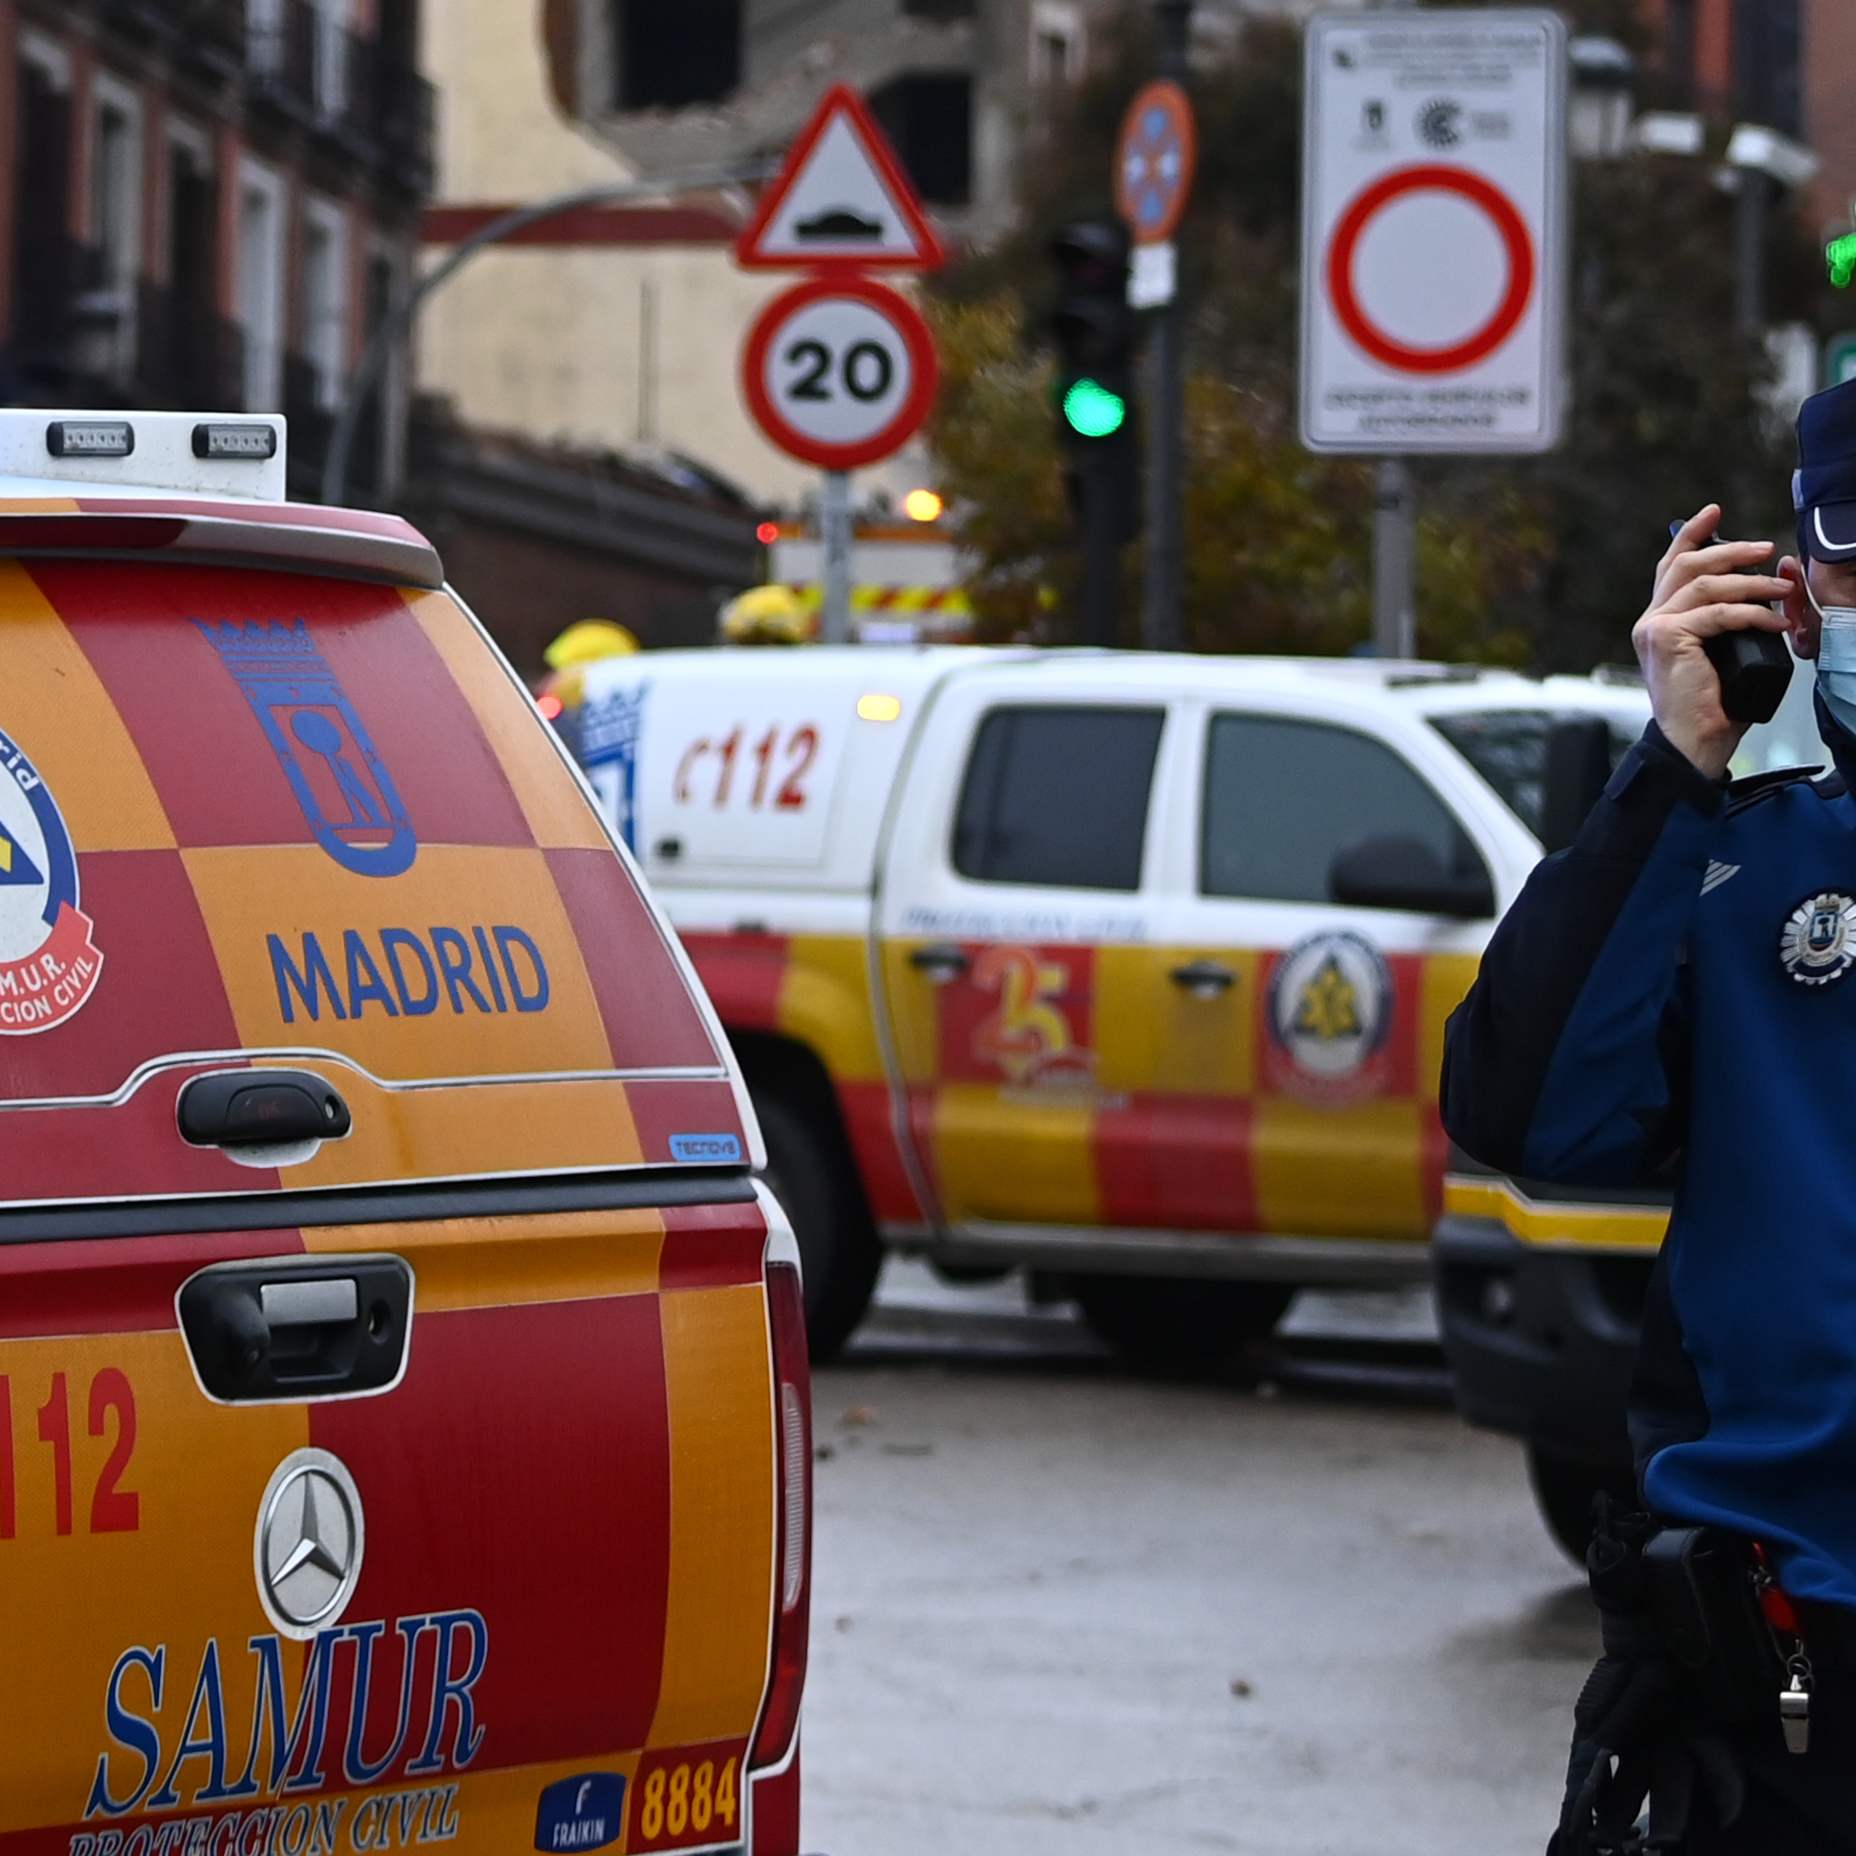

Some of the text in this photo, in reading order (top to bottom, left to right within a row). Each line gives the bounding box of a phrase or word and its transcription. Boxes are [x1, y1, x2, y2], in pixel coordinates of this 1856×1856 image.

[784, 341, 894, 402] 20
[713, 723, 824, 812] 112
[54, 955, 93, 1007] CIVIL
[266, 925, 550, 1024] MADRID
[83, 1607, 489, 1822] SAMUR
[350, 1783, 460, 1851] CIVIL
[552, 1817, 606, 1848] FRAIKIN
[641, 1756, 738, 1840] 8884
